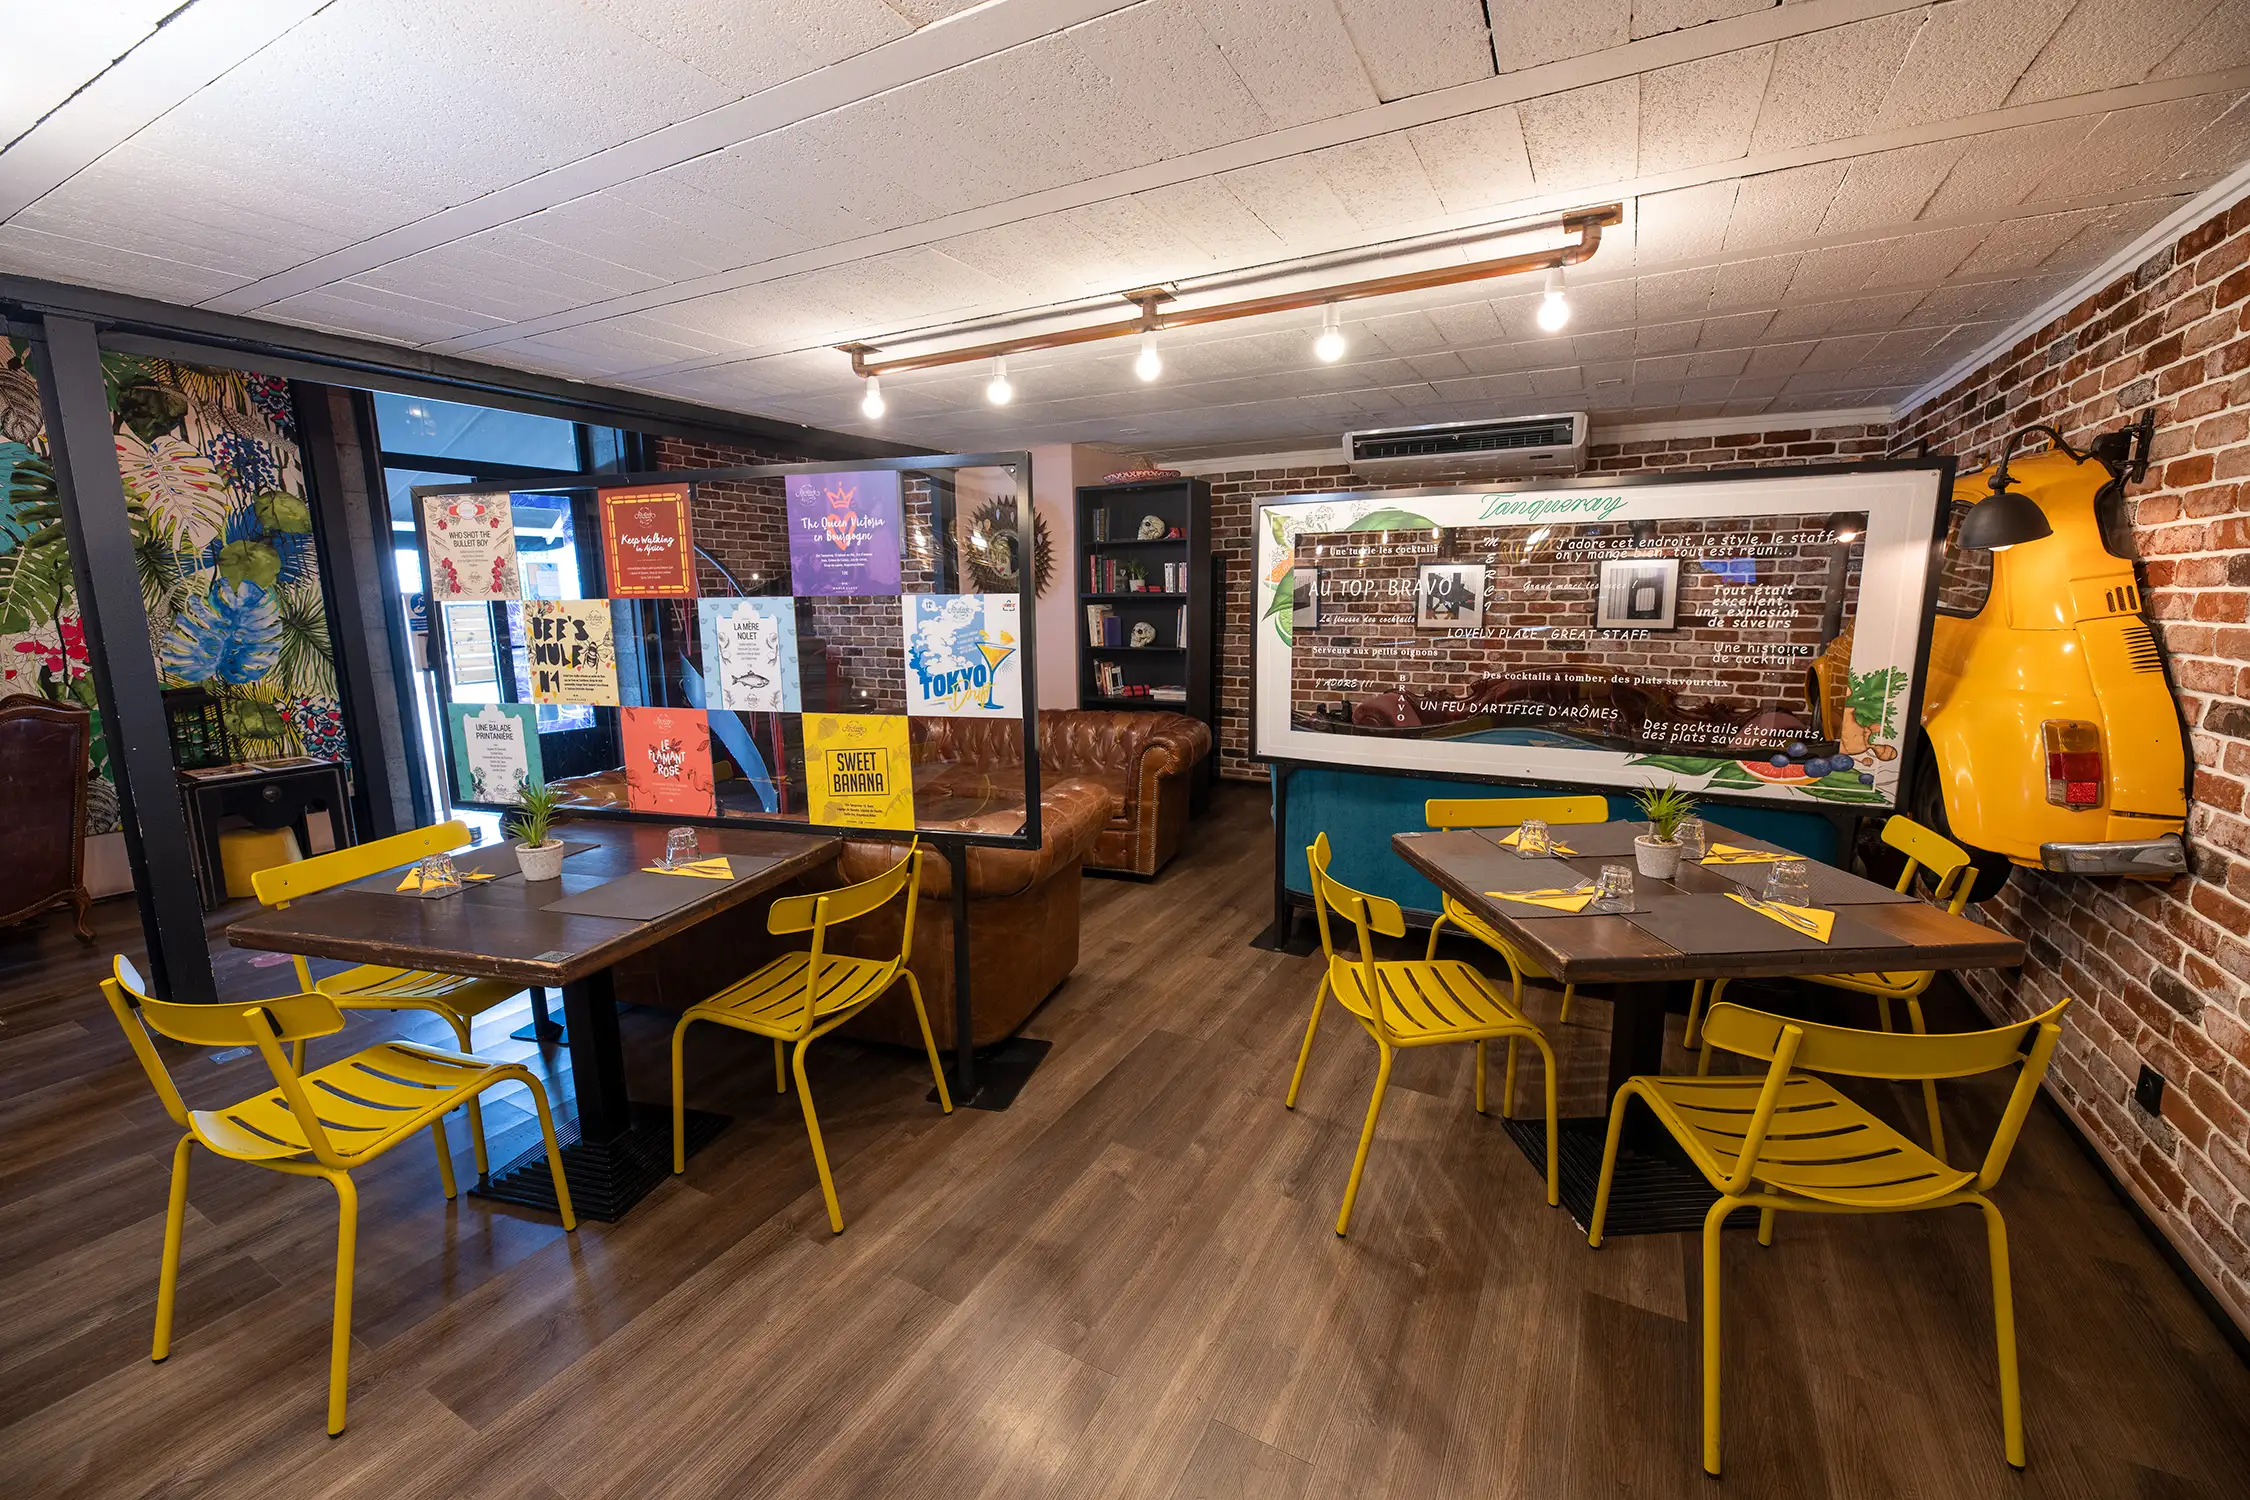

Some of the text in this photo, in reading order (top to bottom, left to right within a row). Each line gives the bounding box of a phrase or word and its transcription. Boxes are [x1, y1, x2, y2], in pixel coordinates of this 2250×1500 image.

[1479, 493, 1628, 521] Tanqueray
[800, 514, 886, 531] The Queen Victoria
[463, 531, 479, 539] SHOT
[621, 534, 640, 548] Keep
[813, 531, 873, 546] en Bourgogne
[1556, 530, 1838, 550] J'adore cet endroit, le style, le staff,
[453, 539, 490, 548] BULLEIT BOY
[644, 544, 665, 556] Africa
[1330, 546, 1346, 556] Une
[1379, 546, 1393, 555] les
[1395, 544, 1439, 554] cocktails
[1556, 552, 1570, 560] on
[1575, 552, 1583, 562] y
[1587, 550, 1628, 562] mange
[1634, 547, 1667, 559] bien,
[1673, 547, 1704, 557] tout
[1709, 546, 1734, 557] est
[1308, 579, 1452, 598] AU TOP, BRAVO
[1523, 580, 1552, 593] Grand
[1586, 581, 1600, 590] les
[1713, 583, 1795, 595] Tout était
[1712, 595, 1789, 608] excellent,
[1333, 614, 1360, 625] finesse
[1363, 614, 1376, 623] des
[1379, 614, 1416, 625] cocktails
[1694, 606, 1799, 620] une explosion
[532, 615, 590, 642] BEE'S
[733, 621, 760, 631] LA MÈRE
[1707, 617, 1792, 628] de saveurs
[737, 632, 757, 640] NOLET
[1447, 628, 1495, 639] LOVELY
[1499, 628, 1538, 639] PLACE
[1551, 629, 1598, 640] GREAT
[1601, 629, 1649, 640] STAFF
[535, 642, 584, 669] MULE
[1312, 646, 1351, 655] Serveurs
[1372, 647, 1398, 657] petits
[1400, 648, 1439, 658] oignons
[1713, 642, 1809, 655] Une histoire
[1712, 652, 1796, 665] de cocktail
[920, 664, 987, 700] TOKYO
[1482, 671, 1729, 688] Des cocktails à tomber, des plats savoureux
[948, 679, 996, 712] Drift
[1397, 674, 1406, 722] BRAVO
[1420, 700, 1619, 719] UN FEU D'ARTIFICE D'ARÔMES
[475, 723, 512, 732] UNE BALADE
[1643, 718, 1825, 742] Des cocktails étonnants,
[475, 732, 514, 741] PRINTANIÈRE
[1642, 729, 1786, 748] des plats savoureux
[661, 738, 670, 752] LE
[647, 749, 686, 766] FLAMANT
[836, 752, 877, 771] SWEET
[657, 764, 680, 778] ROSE
[833, 773, 884, 793] BANANA
